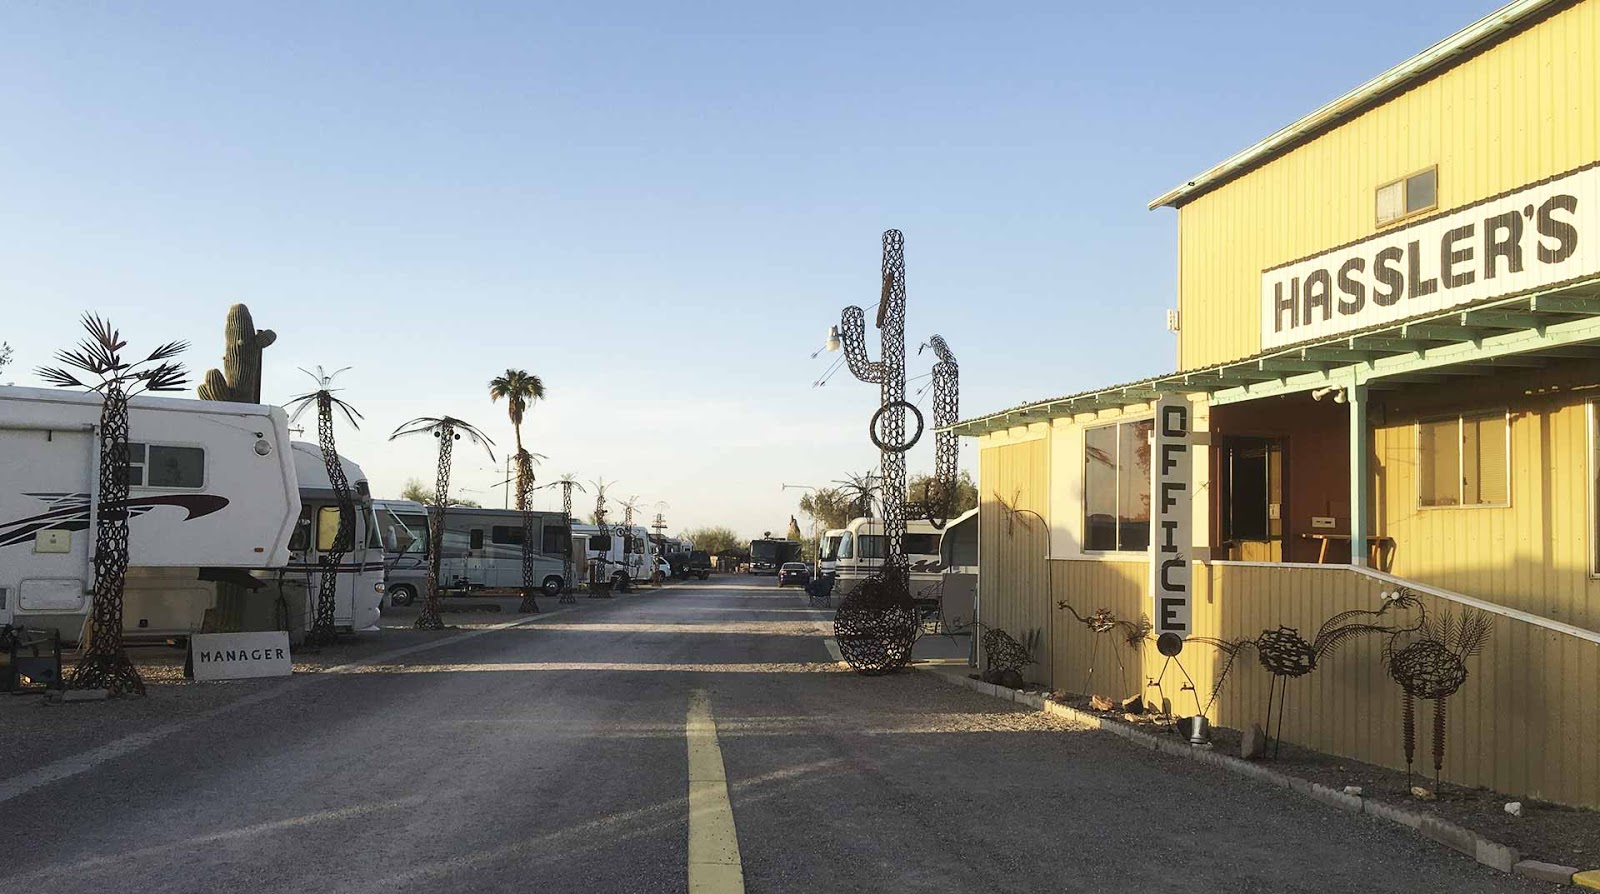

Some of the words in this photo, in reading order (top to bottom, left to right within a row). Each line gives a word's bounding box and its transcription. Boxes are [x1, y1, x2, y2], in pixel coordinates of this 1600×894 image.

[1275, 194, 1578, 333] HASSLER'S
[1160, 405, 1187, 631] OFFICE
[200, 648, 285, 662] MANAGER
